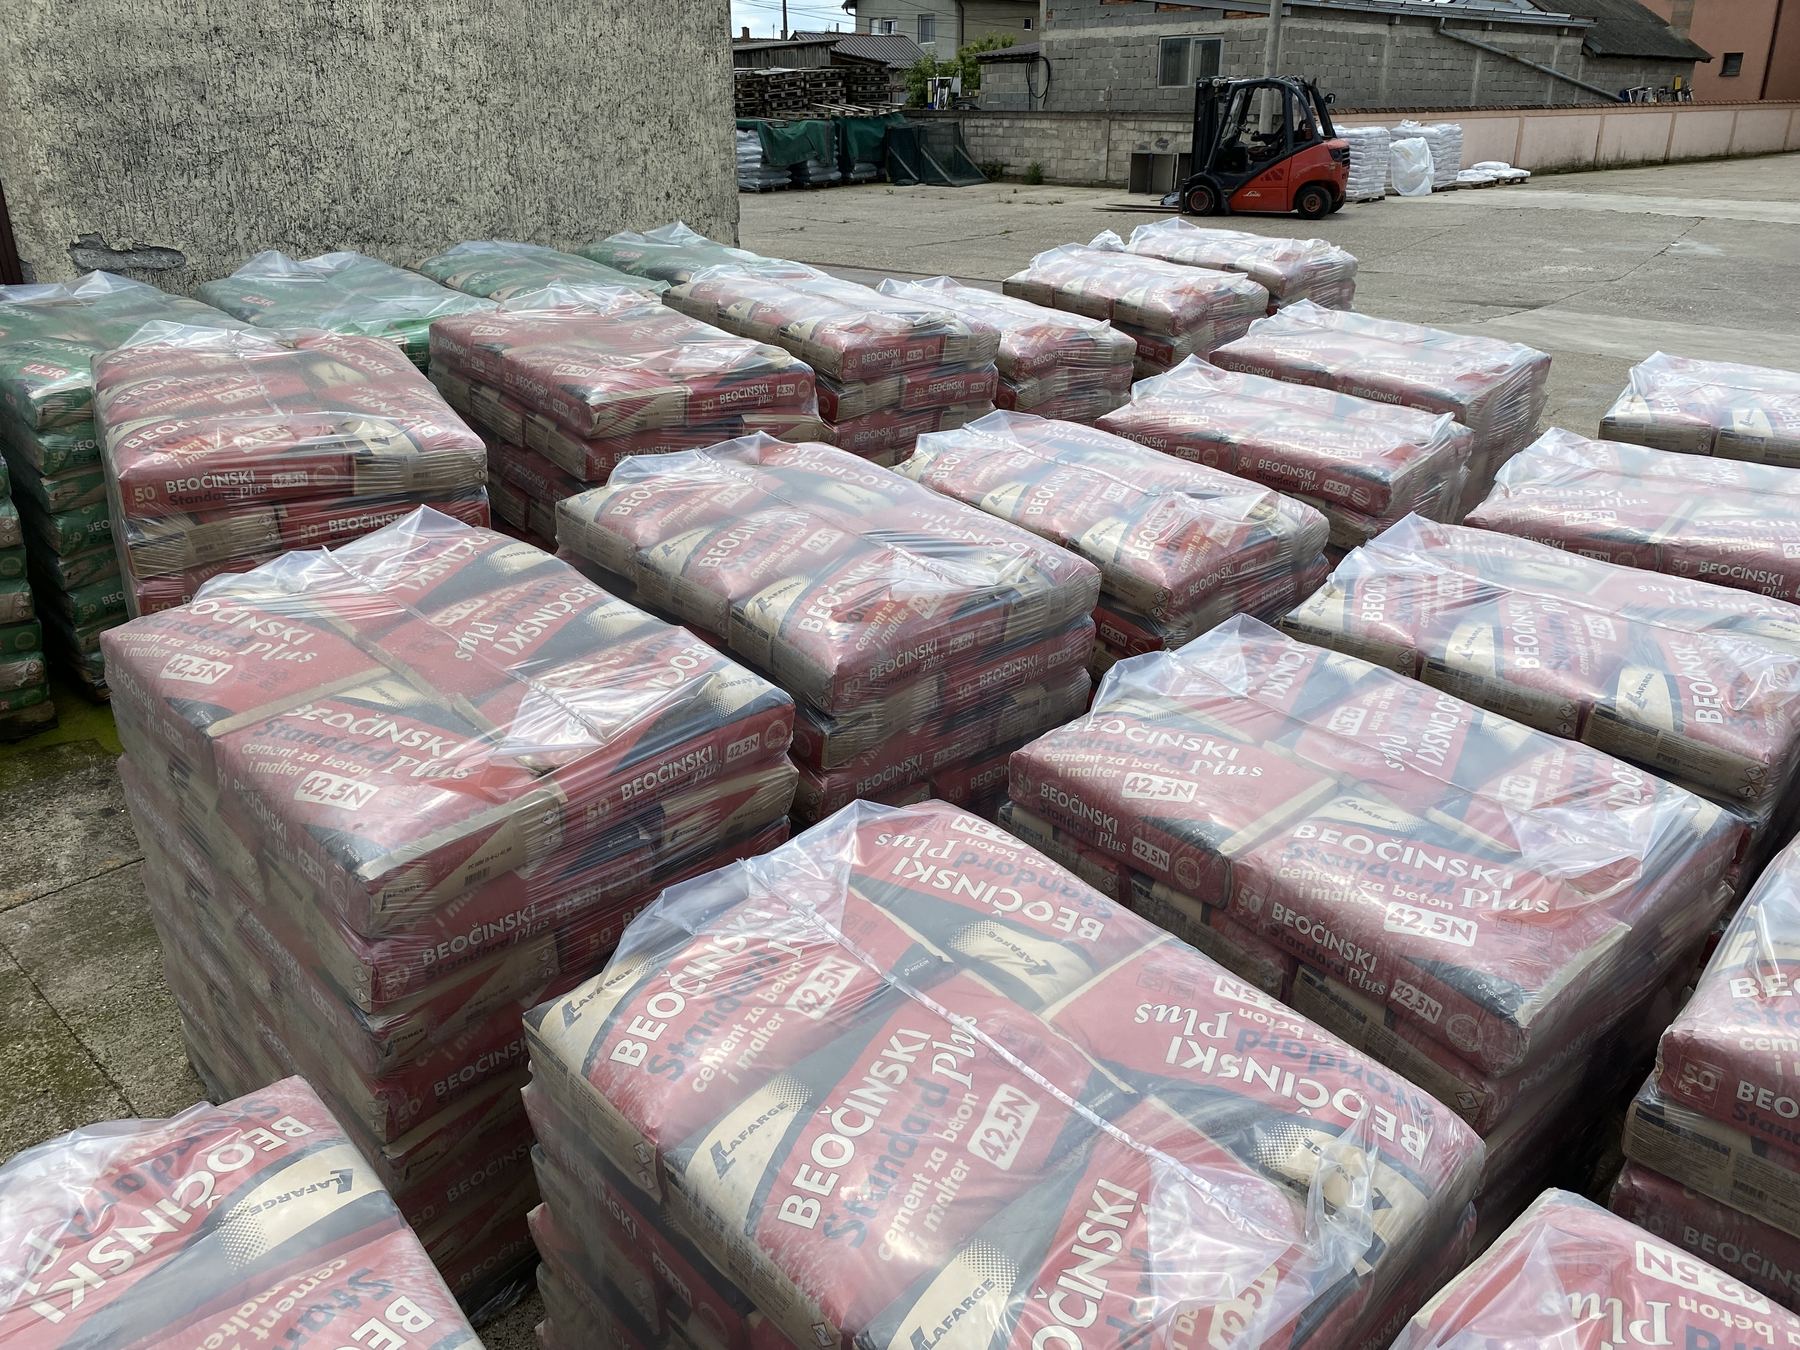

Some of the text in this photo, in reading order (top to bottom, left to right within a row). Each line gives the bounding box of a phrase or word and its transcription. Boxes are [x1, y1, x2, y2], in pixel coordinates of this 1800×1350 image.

[861, 349, 902, 365] BEOČINSKI
[1229, 361, 1274, 379] BEOČINSKI
[720, 384, 769, 405] BEOČINSKI
[1352, 385, 1403, 405] BEOČINSKI
[1116, 430, 1168, 449] BEOČINSKI
[133, 469, 308, 502] 50 BEOČINSKI 42,5N
[1258, 458, 1317, 481] BEOČINSKI
[1671, 559, 1785, 586] 50 BEOČINSKI
[1760, 585, 1791, 599] Plus
[492, 580, 605, 657] BEOČINSKI
[855, 611, 887, 652] cement
[881, 607, 909, 645] malter
[117, 631, 166, 646] cement
[164, 655, 231, 683] 42,5N
[869, 640, 938, 682] BEOČINSKI
[979, 654, 1039, 688] BEOČINSKI
[241, 742, 300, 761] cement
[298, 749, 321, 766] za
[1043, 750, 1103, 765] cement
[1106, 754, 1127, 766] za
[1062, 718, 1240, 761] BEOČINSKI
[256, 757, 306, 777] malter
[584, 736, 759, 823] 50 BEOČINSKI 42,5N
[856, 754, 924, 795] BEOČINSKI
[1066, 764, 1121, 779] malter
[1187, 758, 1265, 778] Plus
[299, 773, 376, 809] 42,5N
[1124, 775, 1196, 800] 42,5N
[1040, 781, 1119, 835] BEOČINSKI
[874, 831, 962, 861] Plus
[963, 836, 1019, 859] beton
[1097, 830, 1128, 853] Plus
[1134, 838, 1168, 869] 42,5N
[1293, 822, 1514, 891] BEOČINSKI
[892, 856, 1106, 943] BEOČINSKI
[1360, 877, 1385, 893] za
[1391, 883, 1454, 911] beton
[1460, 885, 1551, 914] Plus
[421, 903, 538, 966] BEOČINSKI
[1238, 887, 1379, 974] 50 BEOČINSKI
[1387, 903, 1475, 945] 42,5N
[988, 930, 1044, 968] LAFARGE
[789, 957, 855, 1019] 42,5N
[1345, 963, 1388, 997] Plus
[1392, 981, 1440, 1022] 42,5N
[1134, 1001, 1233, 1040] Plus
[433, 1034, 530, 1096] BEOČINSK
[691, 1023, 746, 1094] cement
[744, 1003, 768, 1026] za
[722, 1012, 786, 1084] i malter
[1678, 1080, 1693, 1095] kg
[1682, 1061, 1718, 1094] 50
[1165, 1035, 1434, 1165] BEOČINSKI
[724, 1100, 789, 1158] LAFARGE
[777, 1026, 932, 1230] BEOČINSKI
[973, 1085, 1034, 1168] 42,5N
[878, 1092, 981, 1262] cement za beton
[922, 1157, 971, 1233] malter
[249, 1176, 340, 1218] LAFARGE
[29, 1114, 315, 1324] BEOČINSKI
[250, 1257, 349, 1341] cement
[921, 1277, 996, 1350] LAFARGE
[1678, 1295, 1775, 1345] beton
